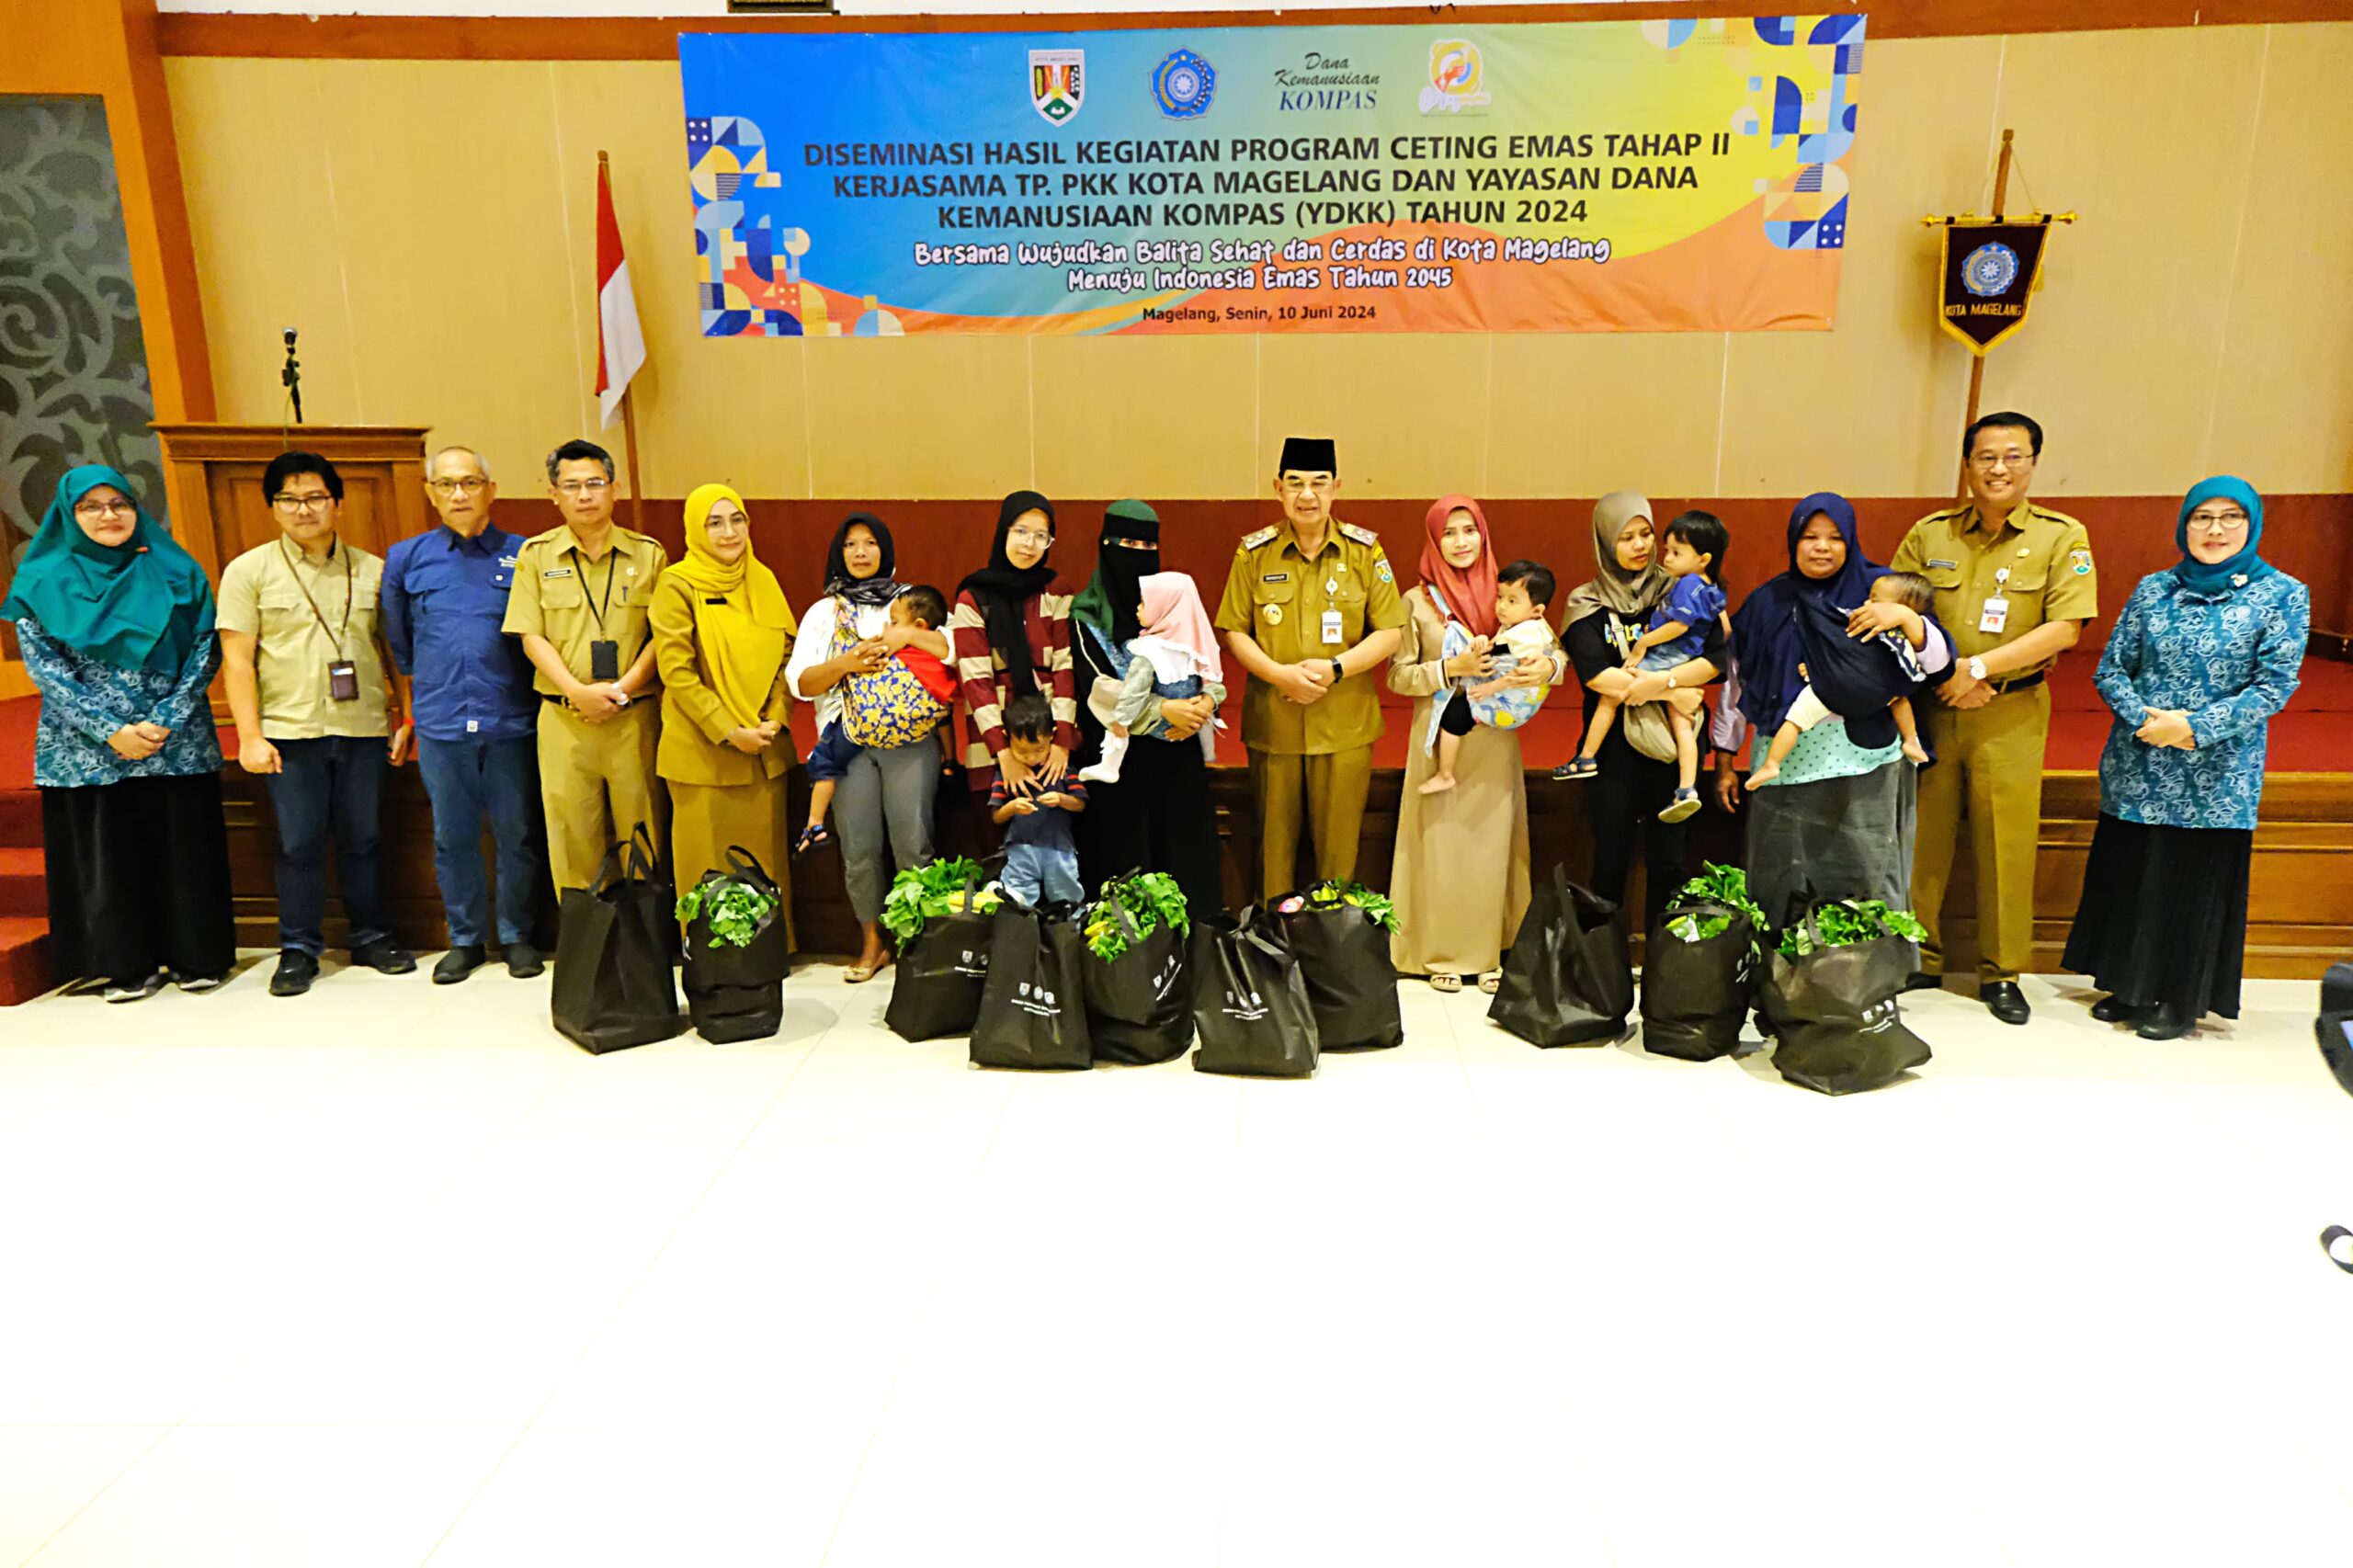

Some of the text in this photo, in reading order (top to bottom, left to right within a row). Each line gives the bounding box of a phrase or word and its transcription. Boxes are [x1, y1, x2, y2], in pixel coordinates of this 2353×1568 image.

[1304, 51, 1349, 70] Dana
[1274, 69, 1381, 87] Kemanusiaan
[1279, 89, 1378, 111] KOMPAS
[804, 132, 1730, 166] DISEMINASI HASIL KEGIATAN PROGRAM CETING EMAS TAHAP II
[834, 165, 1699, 199] KERJASAMA TP. PKK KOTA MAGELANG DAN YAYASAN DANA
[938, 199, 1587, 229] KEMANUSIAAN KOMPAS (YDKK) TAHUN 2024
[914, 236, 1611, 268] Bersama Wujudkan Balita Sehat dan Cerdas di Kota Magelang
[1067, 265, 1453, 293] Menuju Indonesia Emas Tahun 2045
[1142, 304, 1377, 323] Magelang, Senin, 10 Juni 2024
[1946, 303, 2022, 316] KOTA MAGELANG
